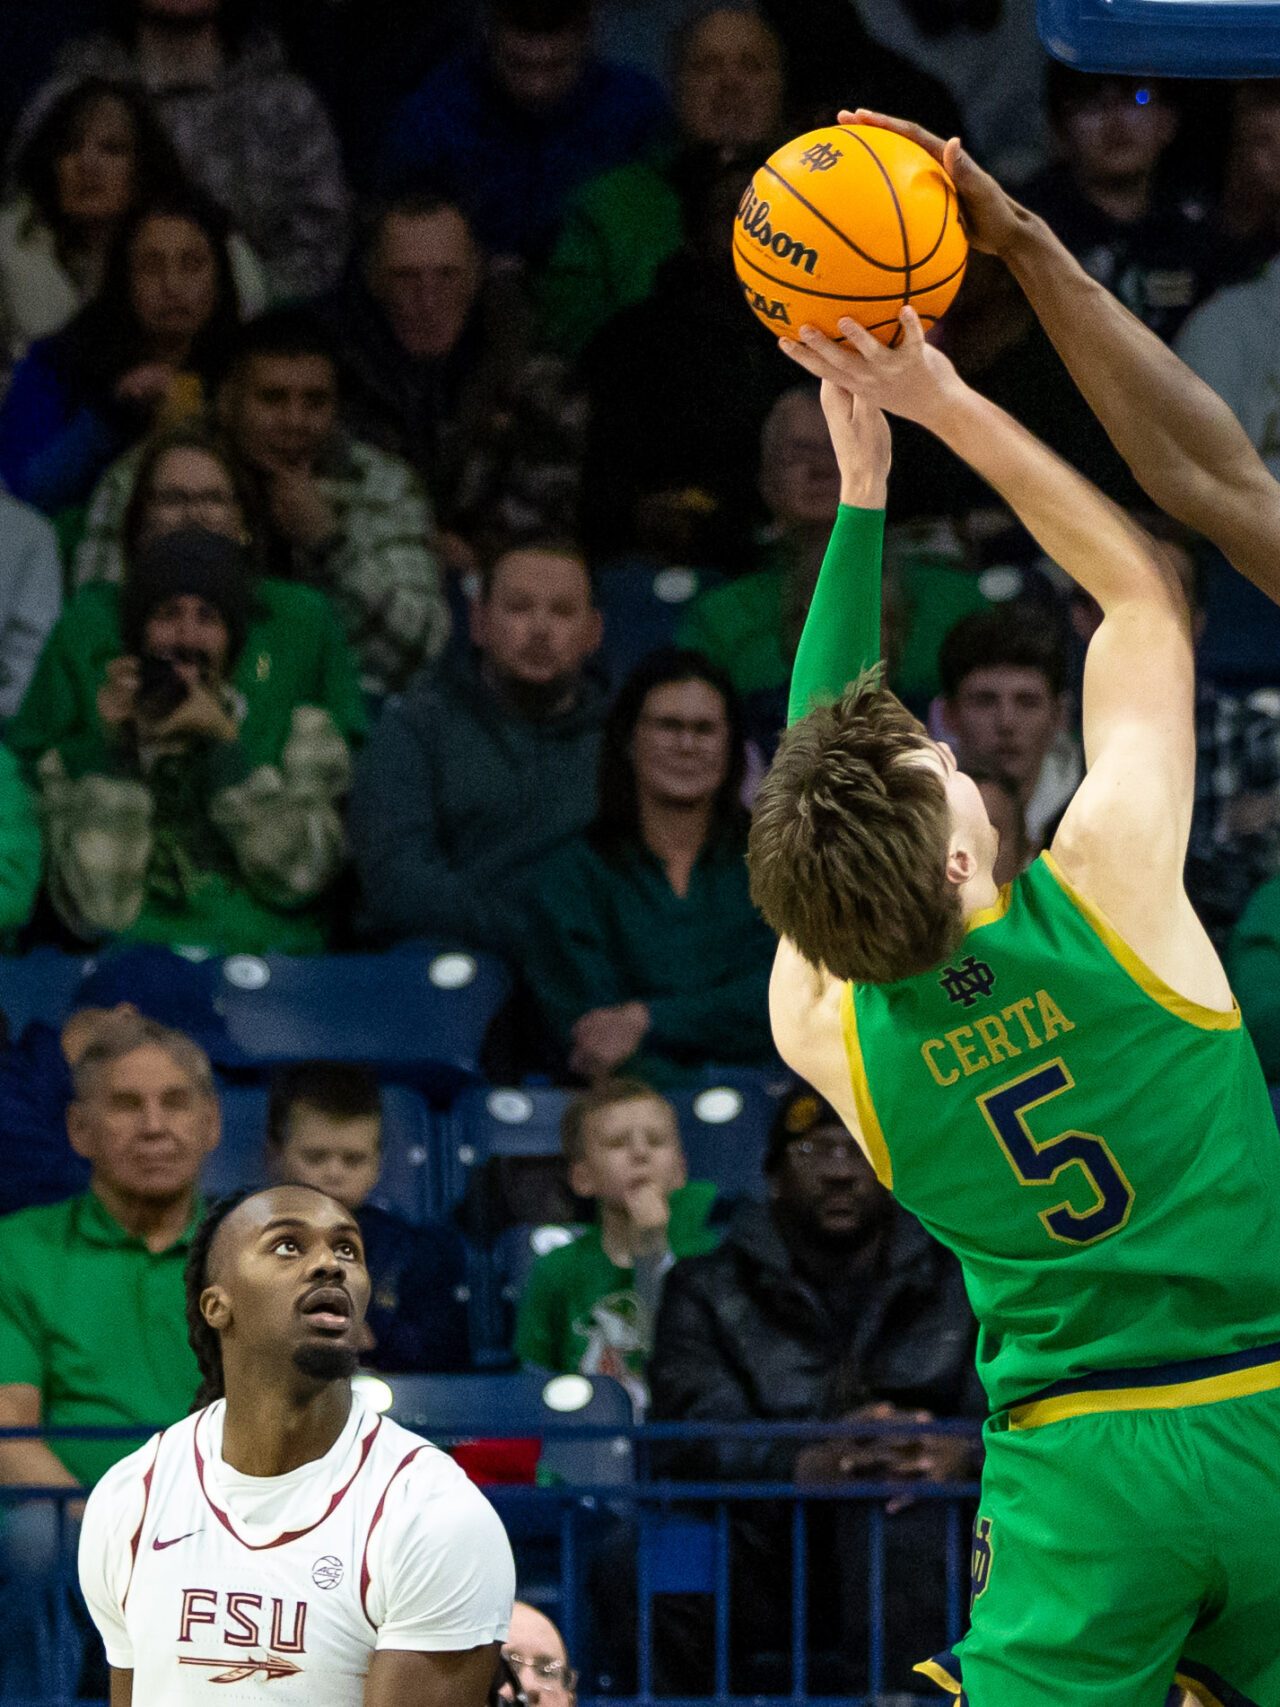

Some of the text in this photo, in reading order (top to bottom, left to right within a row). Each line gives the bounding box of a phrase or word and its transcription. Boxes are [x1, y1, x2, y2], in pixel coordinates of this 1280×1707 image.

[744, 283, 792, 326] AA
[920, 989, 1076, 1086] CERTA
[975, 1056, 1136, 1246] 5
[176, 1588, 308, 1653] FSU
